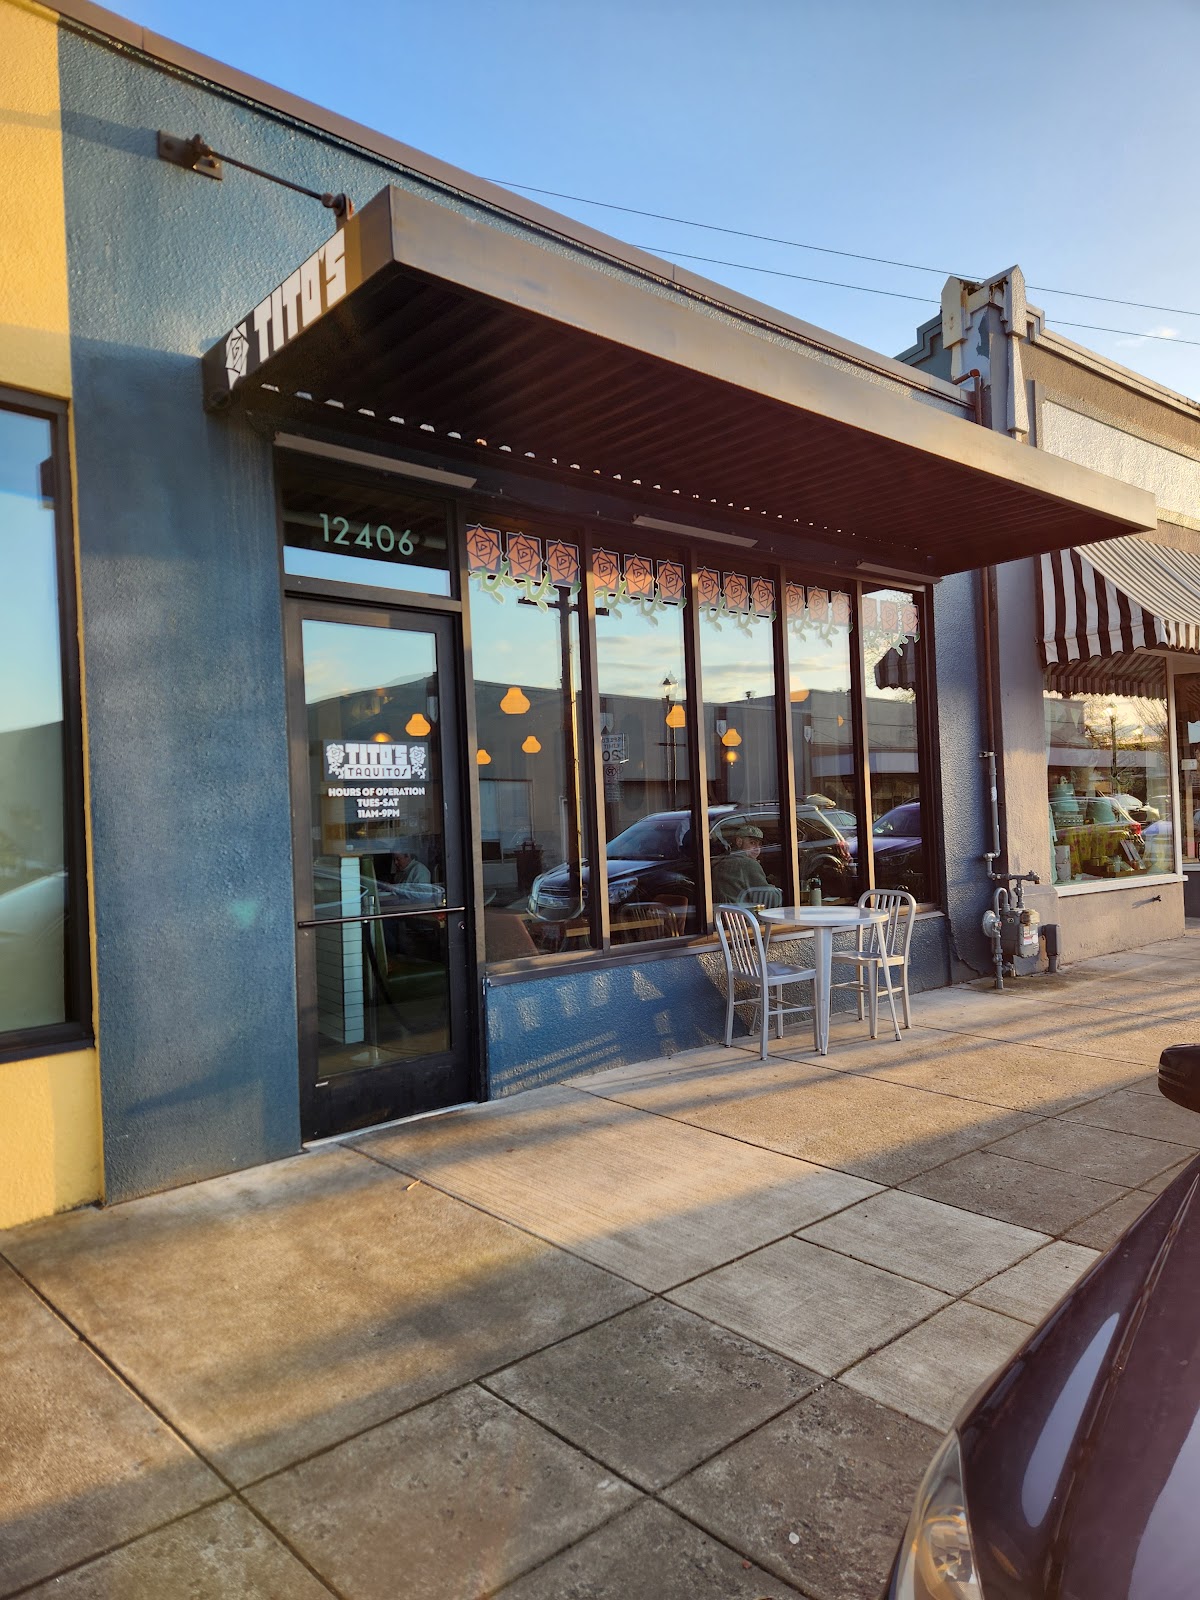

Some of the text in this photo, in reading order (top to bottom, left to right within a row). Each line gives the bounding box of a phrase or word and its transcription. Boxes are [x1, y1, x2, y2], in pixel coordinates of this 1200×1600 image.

[254, 227, 347, 364] TITO'S
[319, 513, 414, 556] 12406
[345, 743, 407, 765] TITO'S
[348, 768, 407, 777] TAQUITOS
[328, 787, 425, 797] HOURS OF OPERATION
[357, 798, 399, 807] TUES-SAT
[357, 809, 400, 818] 11AM-9PM
